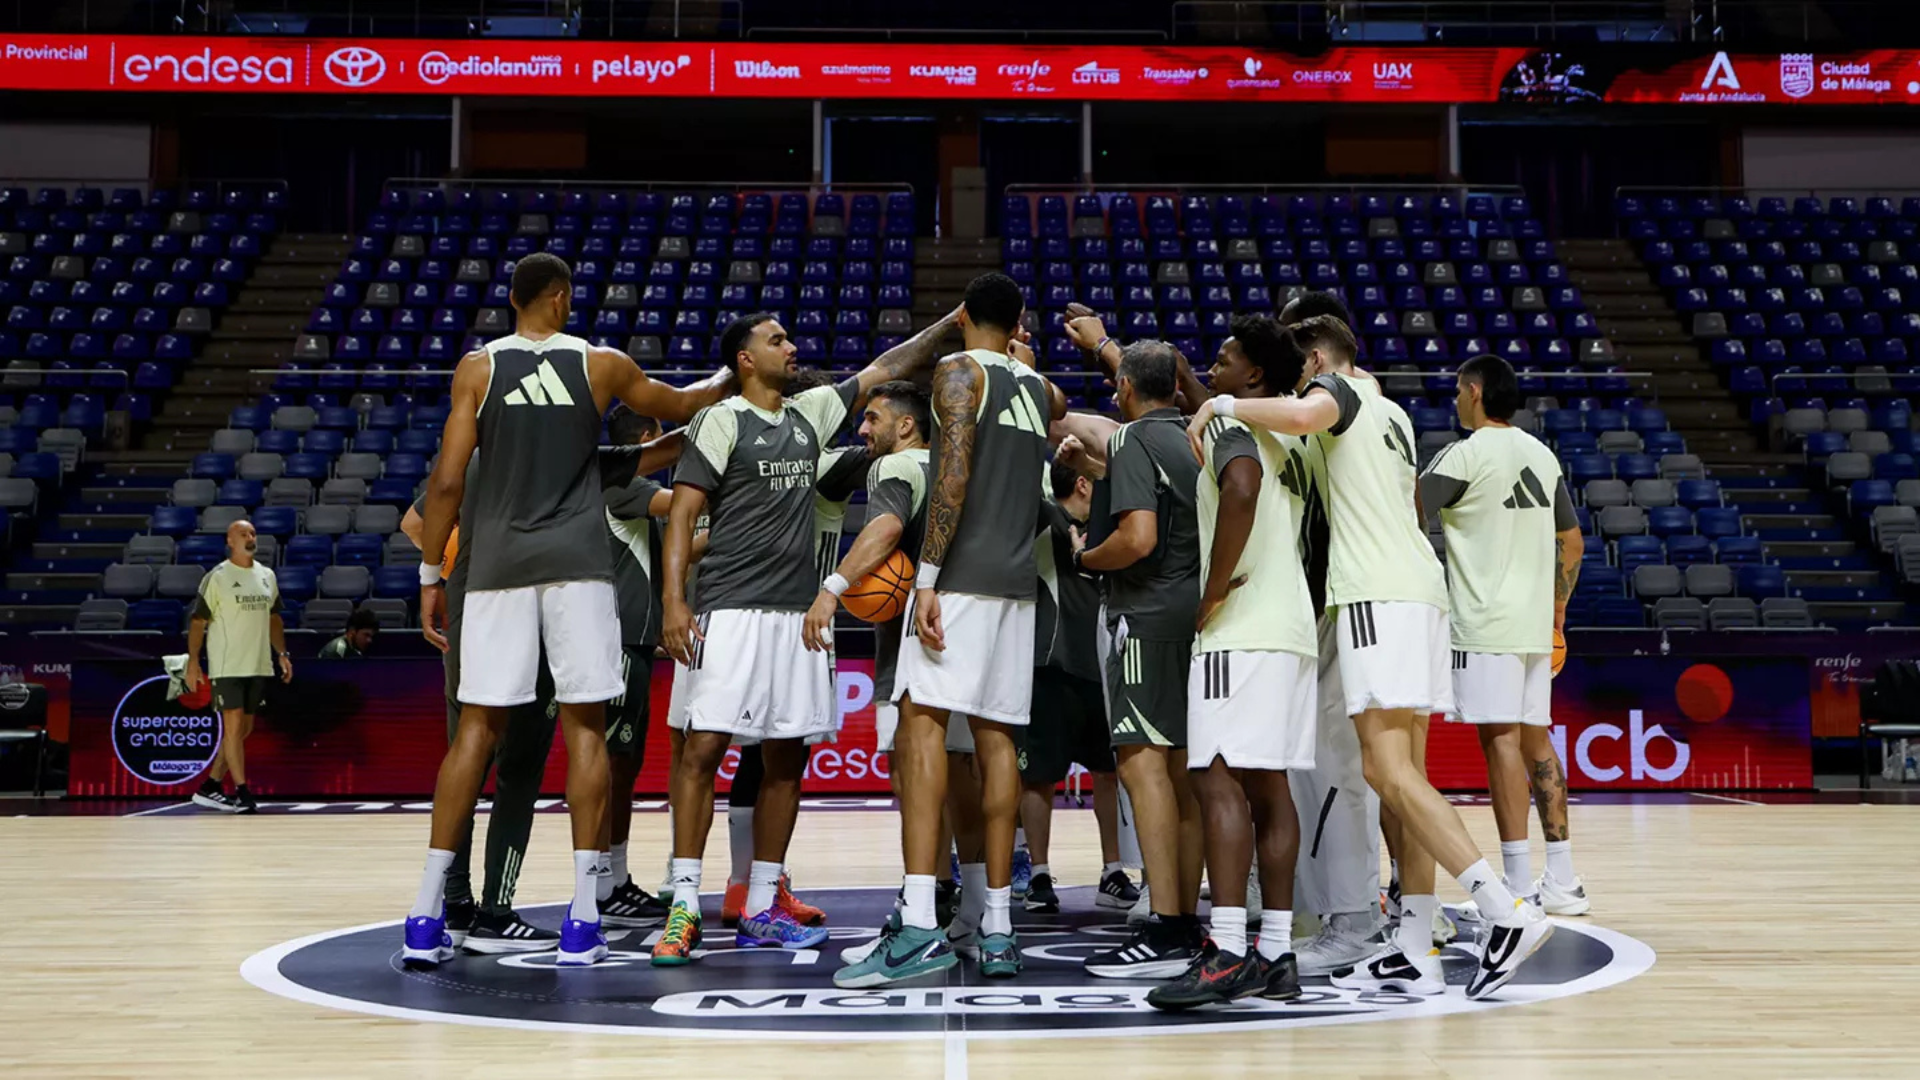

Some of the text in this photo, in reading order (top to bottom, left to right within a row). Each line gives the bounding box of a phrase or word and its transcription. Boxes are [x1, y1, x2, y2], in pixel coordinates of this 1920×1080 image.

[6, 44, 88, 60] Provincial
[124, 47, 292, 82] endesa
[424, 56, 562, 76] mediolanum
[593, 55, 675, 83] pelayo
[734, 60, 800, 78] Wilson
[821, 65, 891, 75] azulmarino
[910, 65, 977, 76] KUMHO
[998, 59, 1051, 80] renfe
[1373, 62, 1412, 79] UAX
[1821, 61, 1870, 75] Ciudad
[945, 76, 976, 85] TIRE
[1072, 71, 1120, 84] LOTUS
[1293, 70, 1351, 83] ONEBOX
[1821, 76, 1891, 93] de Málaga
[757, 458, 814, 477] Emirates
[33, 664, 71, 673] KUM
[1815, 652, 1861, 671] renfe
[122, 716, 212, 730] supercopa
[130, 729, 212, 747] endesa
